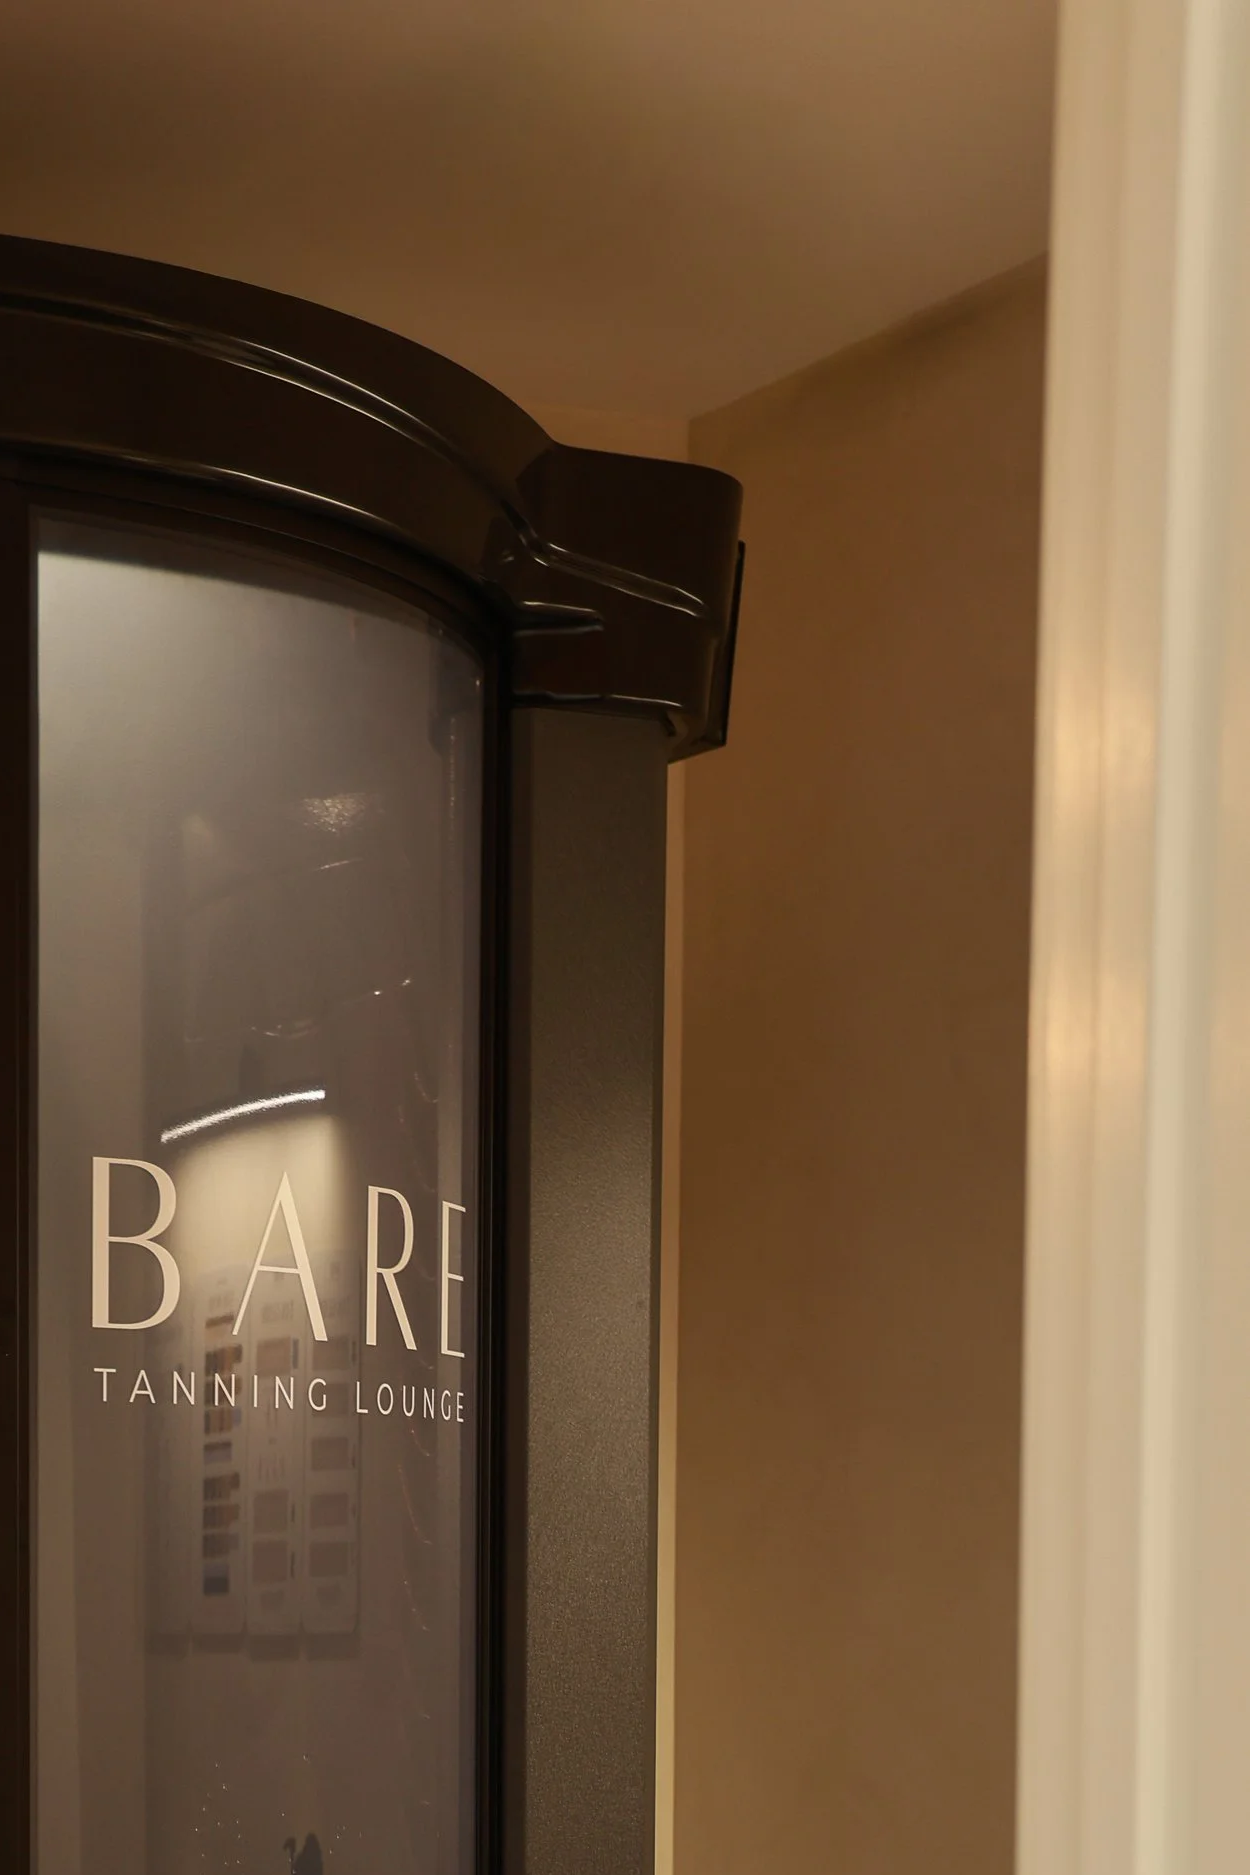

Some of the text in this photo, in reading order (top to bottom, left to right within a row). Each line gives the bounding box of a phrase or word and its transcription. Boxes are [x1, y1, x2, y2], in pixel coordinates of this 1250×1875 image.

[91, 1156, 467, 1358] BARE
[93, 1367, 465, 1423] TANNING LOUNGE
